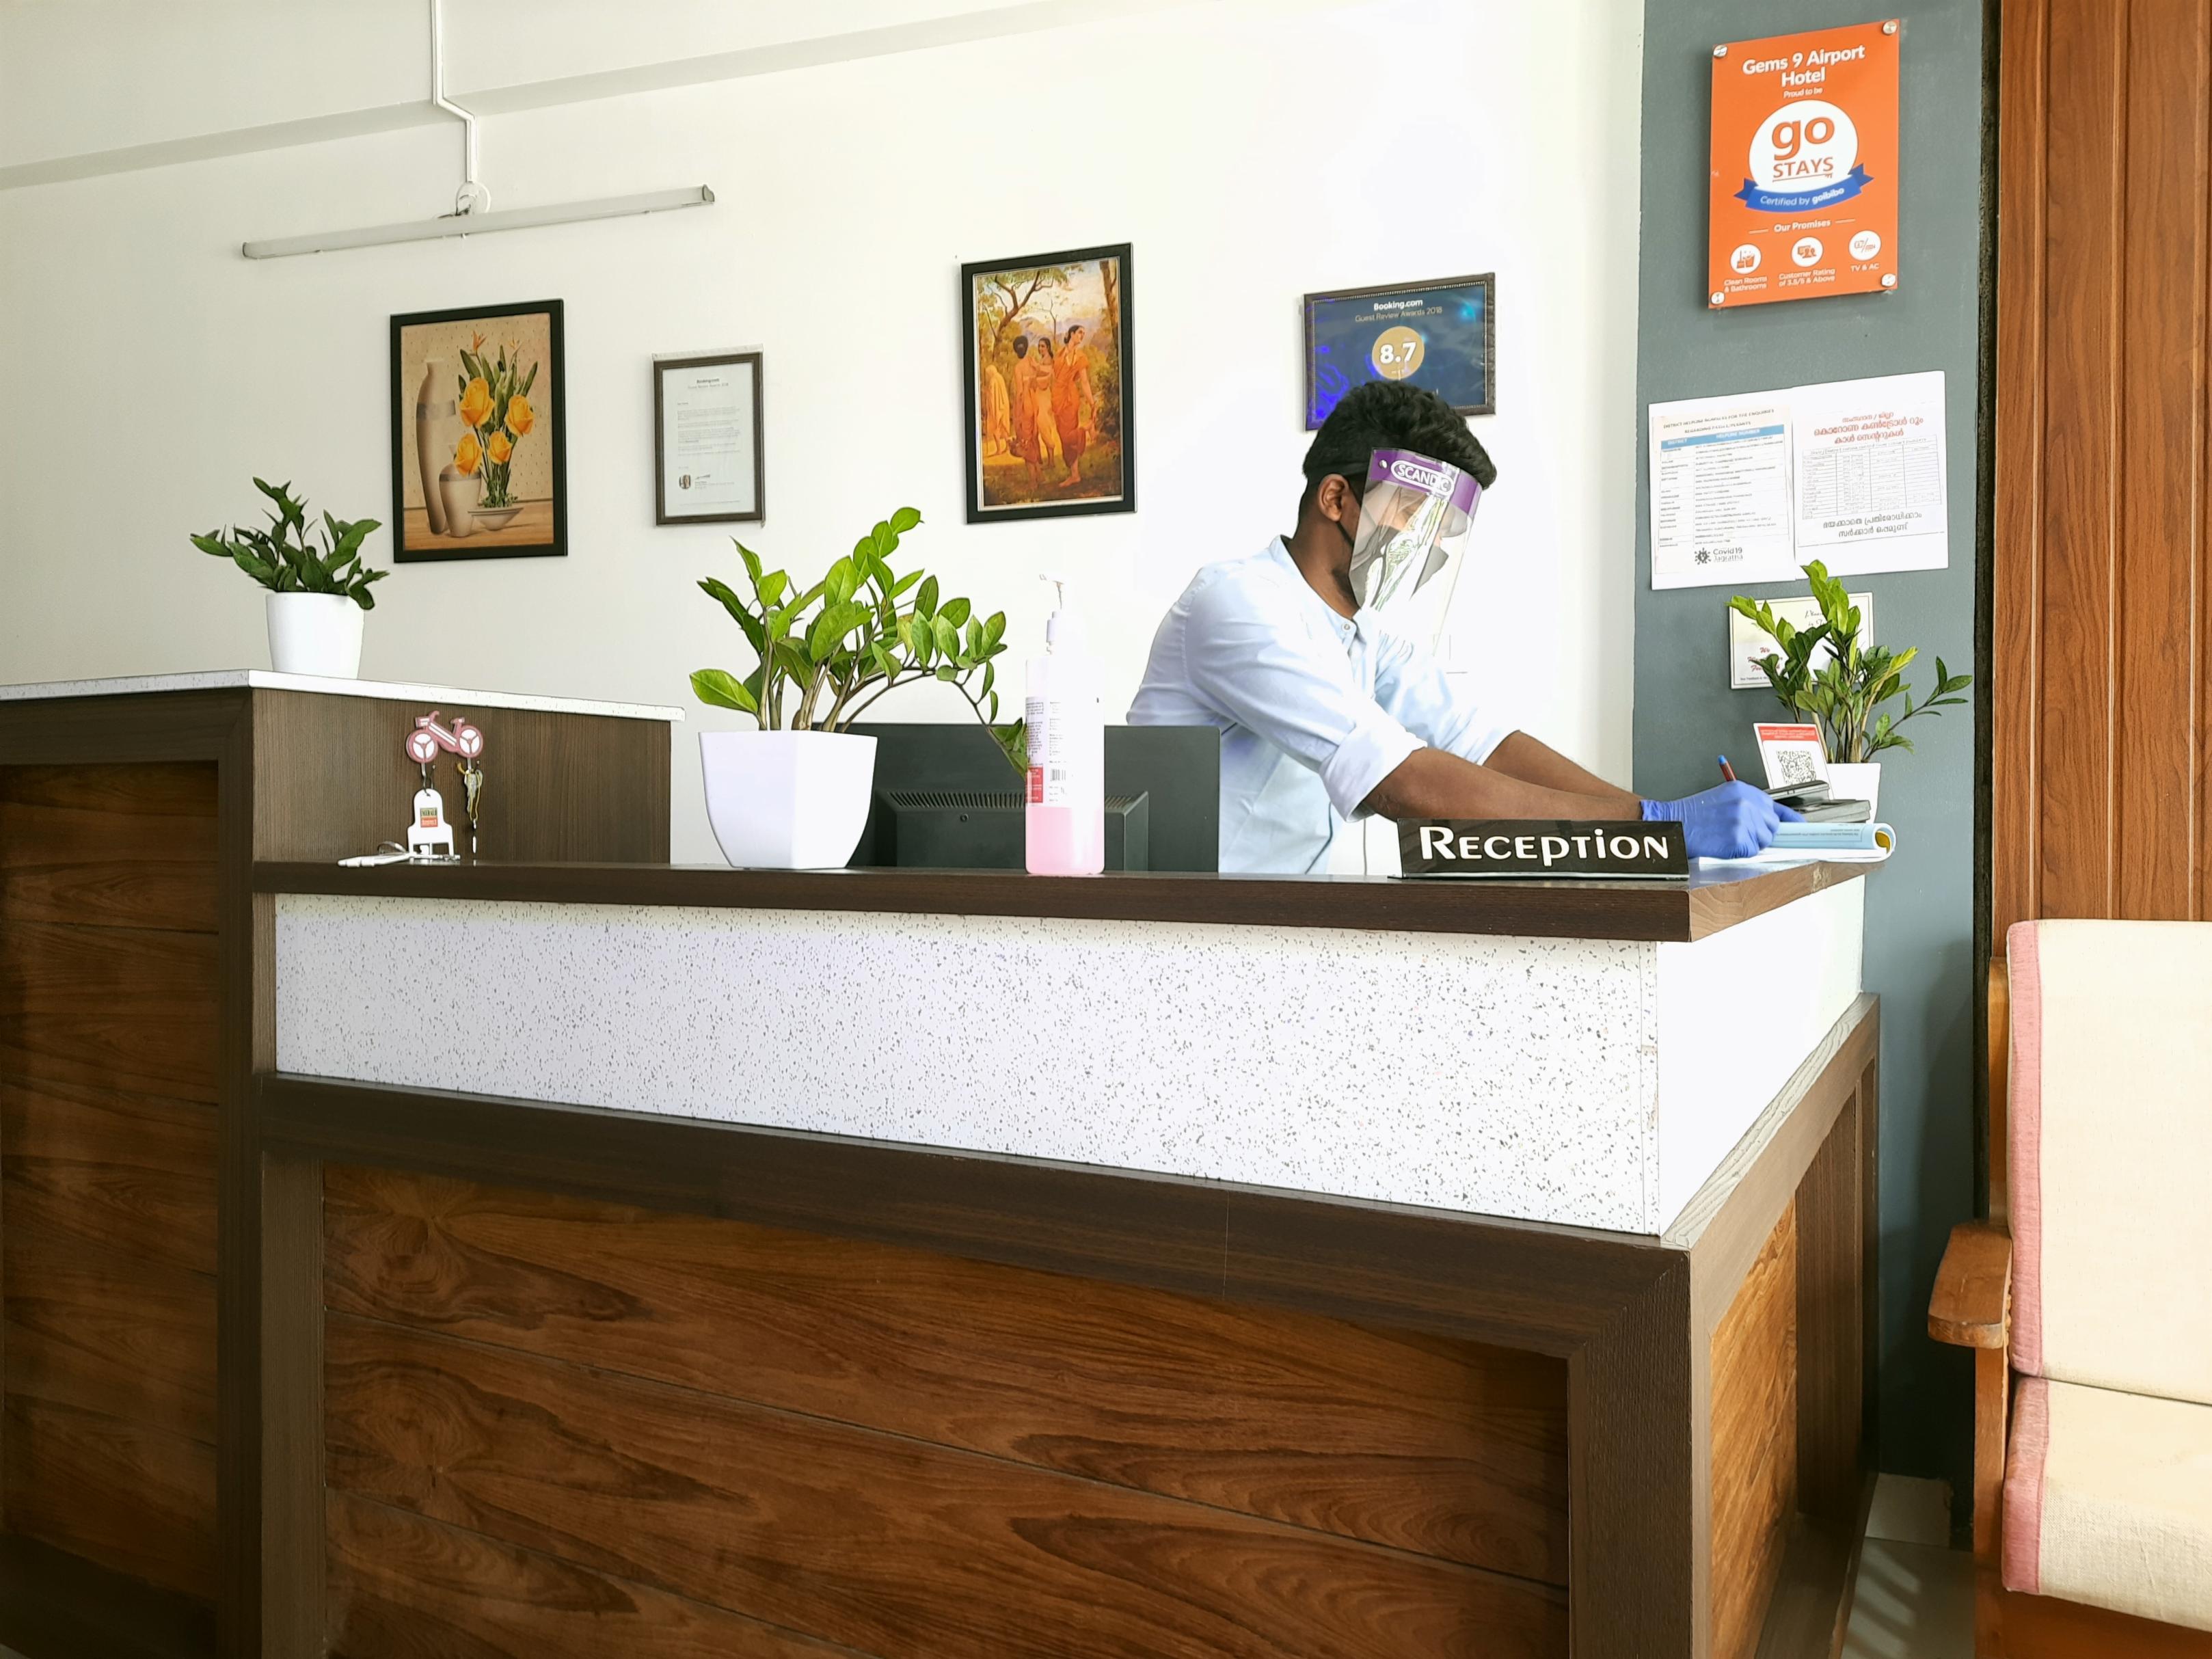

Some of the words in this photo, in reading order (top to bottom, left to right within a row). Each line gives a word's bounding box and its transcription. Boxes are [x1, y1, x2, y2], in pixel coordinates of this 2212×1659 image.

[1742, 57, 1788, 75] Gems
[1792, 52, 1804, 68] 9
[1806, 44, 1865, 66] Airport
[1781, 67, 1826, 87] Hotel
[1783, 89, 1805, 98] Proud
[1813, 86, 1823, 94] be
[1771, 116, 1835, 161] go
[1772, 157, 1834, 178] STAYS
[1760, 195, 1797, 206] Certified
[1798, 196, 1810, 206] by
[1774, 222, 1791, 232] Our
[1792, 219, 1831, 230] Promises
[1724, 278, 1743, 286] Clean
[1744, 275, 1768, 284] Rooms
[1779, 270, 1812, 280] Customer
[1731, 282, 1767, 293] Bathrooms
[1373, 299, 1423, 311] Booking.com
[1355, 314, 1375, 323] Guest
[1376, 311, 1400, 321] Review
[1400, 309, 1426, 318] Awards
[1426, 306, 1443, 316] 2018
[1379, 342, 1416, 364] 8.7
